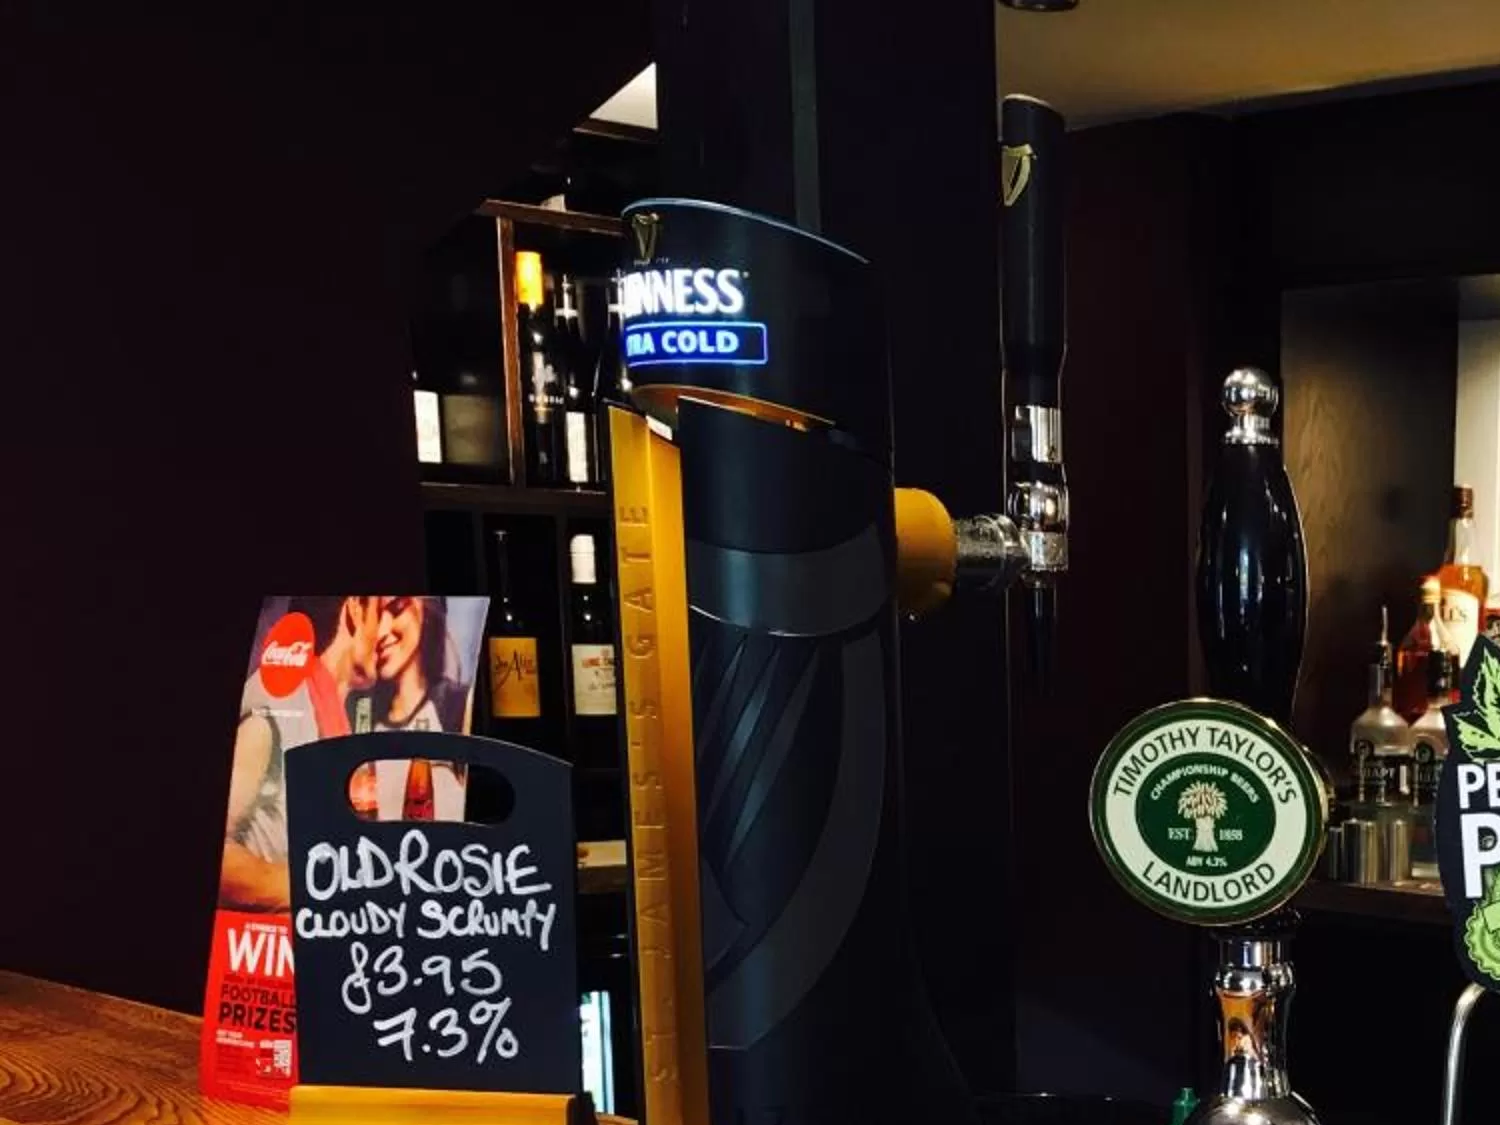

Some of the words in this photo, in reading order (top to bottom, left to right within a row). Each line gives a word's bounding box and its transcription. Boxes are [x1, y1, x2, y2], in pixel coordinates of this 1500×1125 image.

[661, 329, 740, 354] COLD
[619, 505, 656, 660] GATE
[1113, 726, 1201, 799] TIMOTHY
[1205, 726, 1298, 806] TAYLOR'S
[305, 835, 398, 901] OLD
[399, 829, 554, 899] ROSIE
[1141, 860, 1277, 903] LANDLORD
[296, 902, 407, 939] CLOUDY
[415, 900, 558, 952] SCRUMPY
[227, 927, 295, 978] WIN
[218, 1001, 297, 1034] PRIZES
[372, 997, 520, 1065] 7.3%
